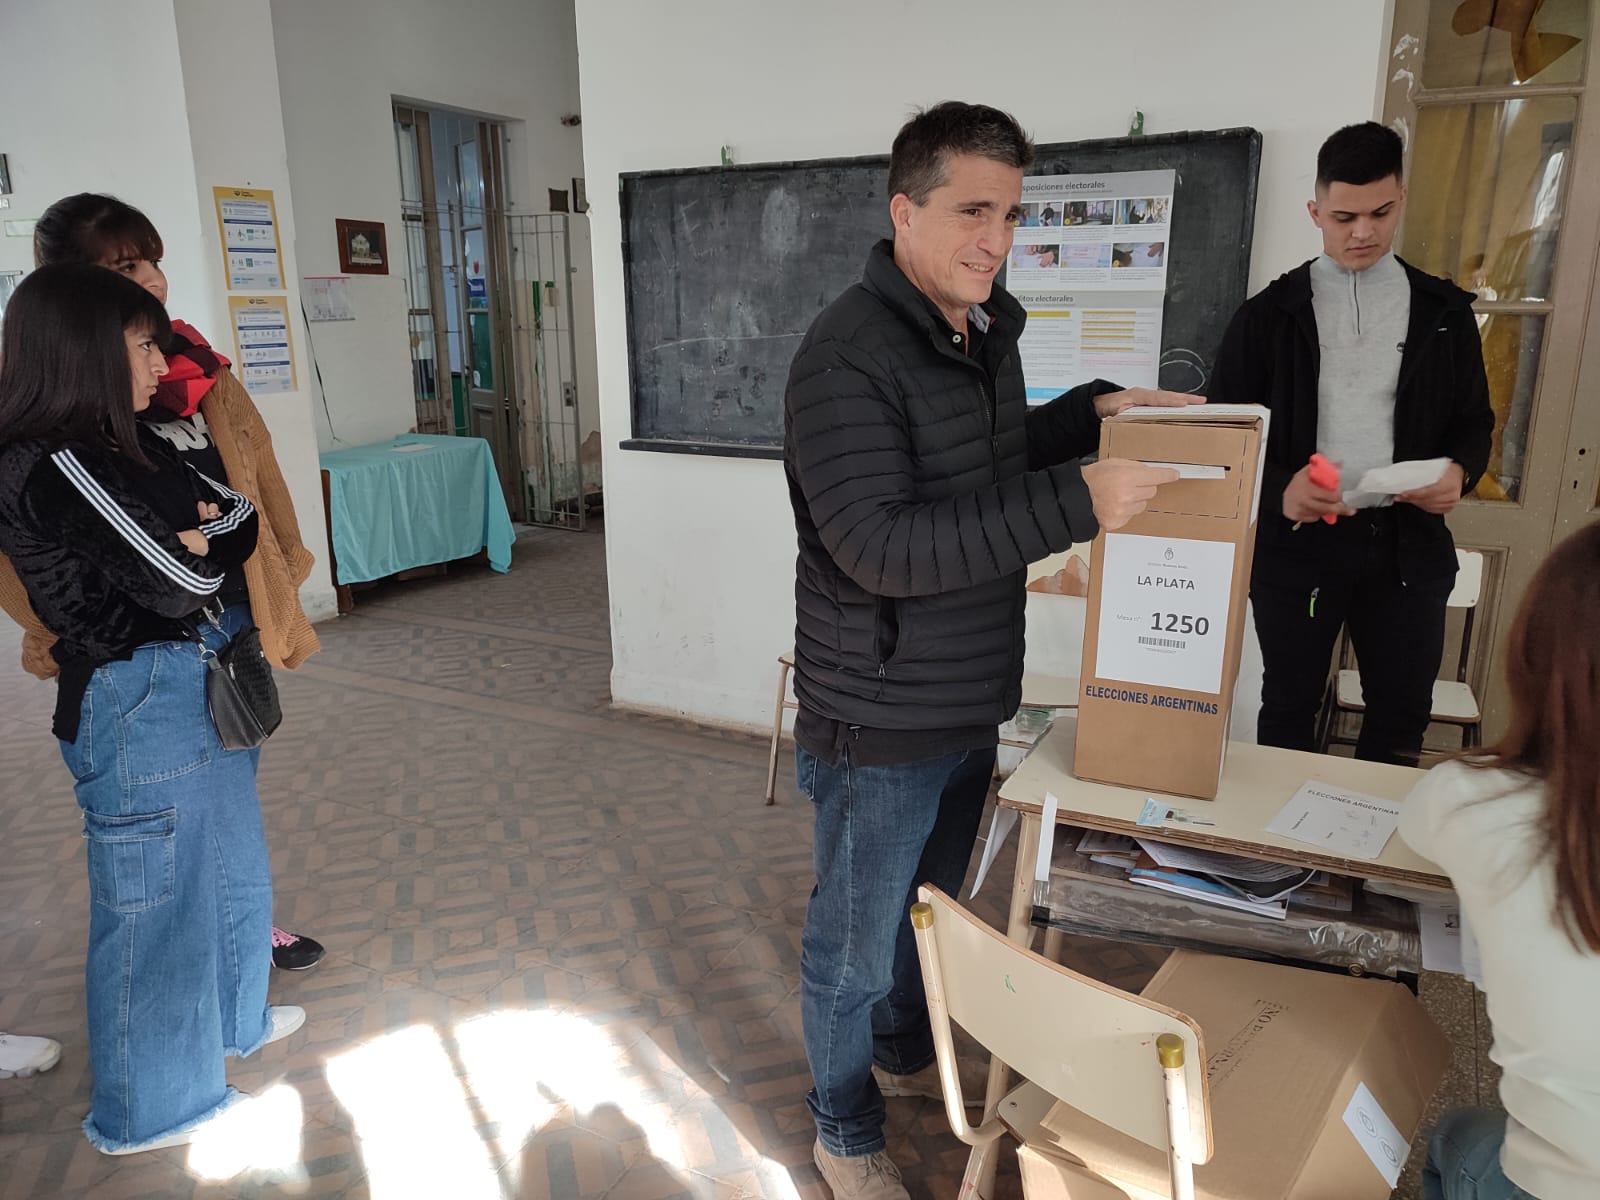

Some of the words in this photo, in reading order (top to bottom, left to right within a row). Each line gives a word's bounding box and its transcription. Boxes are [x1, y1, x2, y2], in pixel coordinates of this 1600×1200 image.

[1022, 182, 1064, 192] sposiciones
[1065, 180, 1106, 190] electorales
[1035, 294, 1074, 302] electorales
[1137, 575, 1152, 586] LA
[1155, 576, 1195, 590] PLATA
[1150, 612, 1210, 636] 1250
[1086, 685, 1149, 705] ELECCIONES
[1151, 694, 1218, 715] ARGENTINAS
[1307, 789, 1351, 805] ELECCIONES
[1352, 800, 1399, 816] ARGENTINAS
